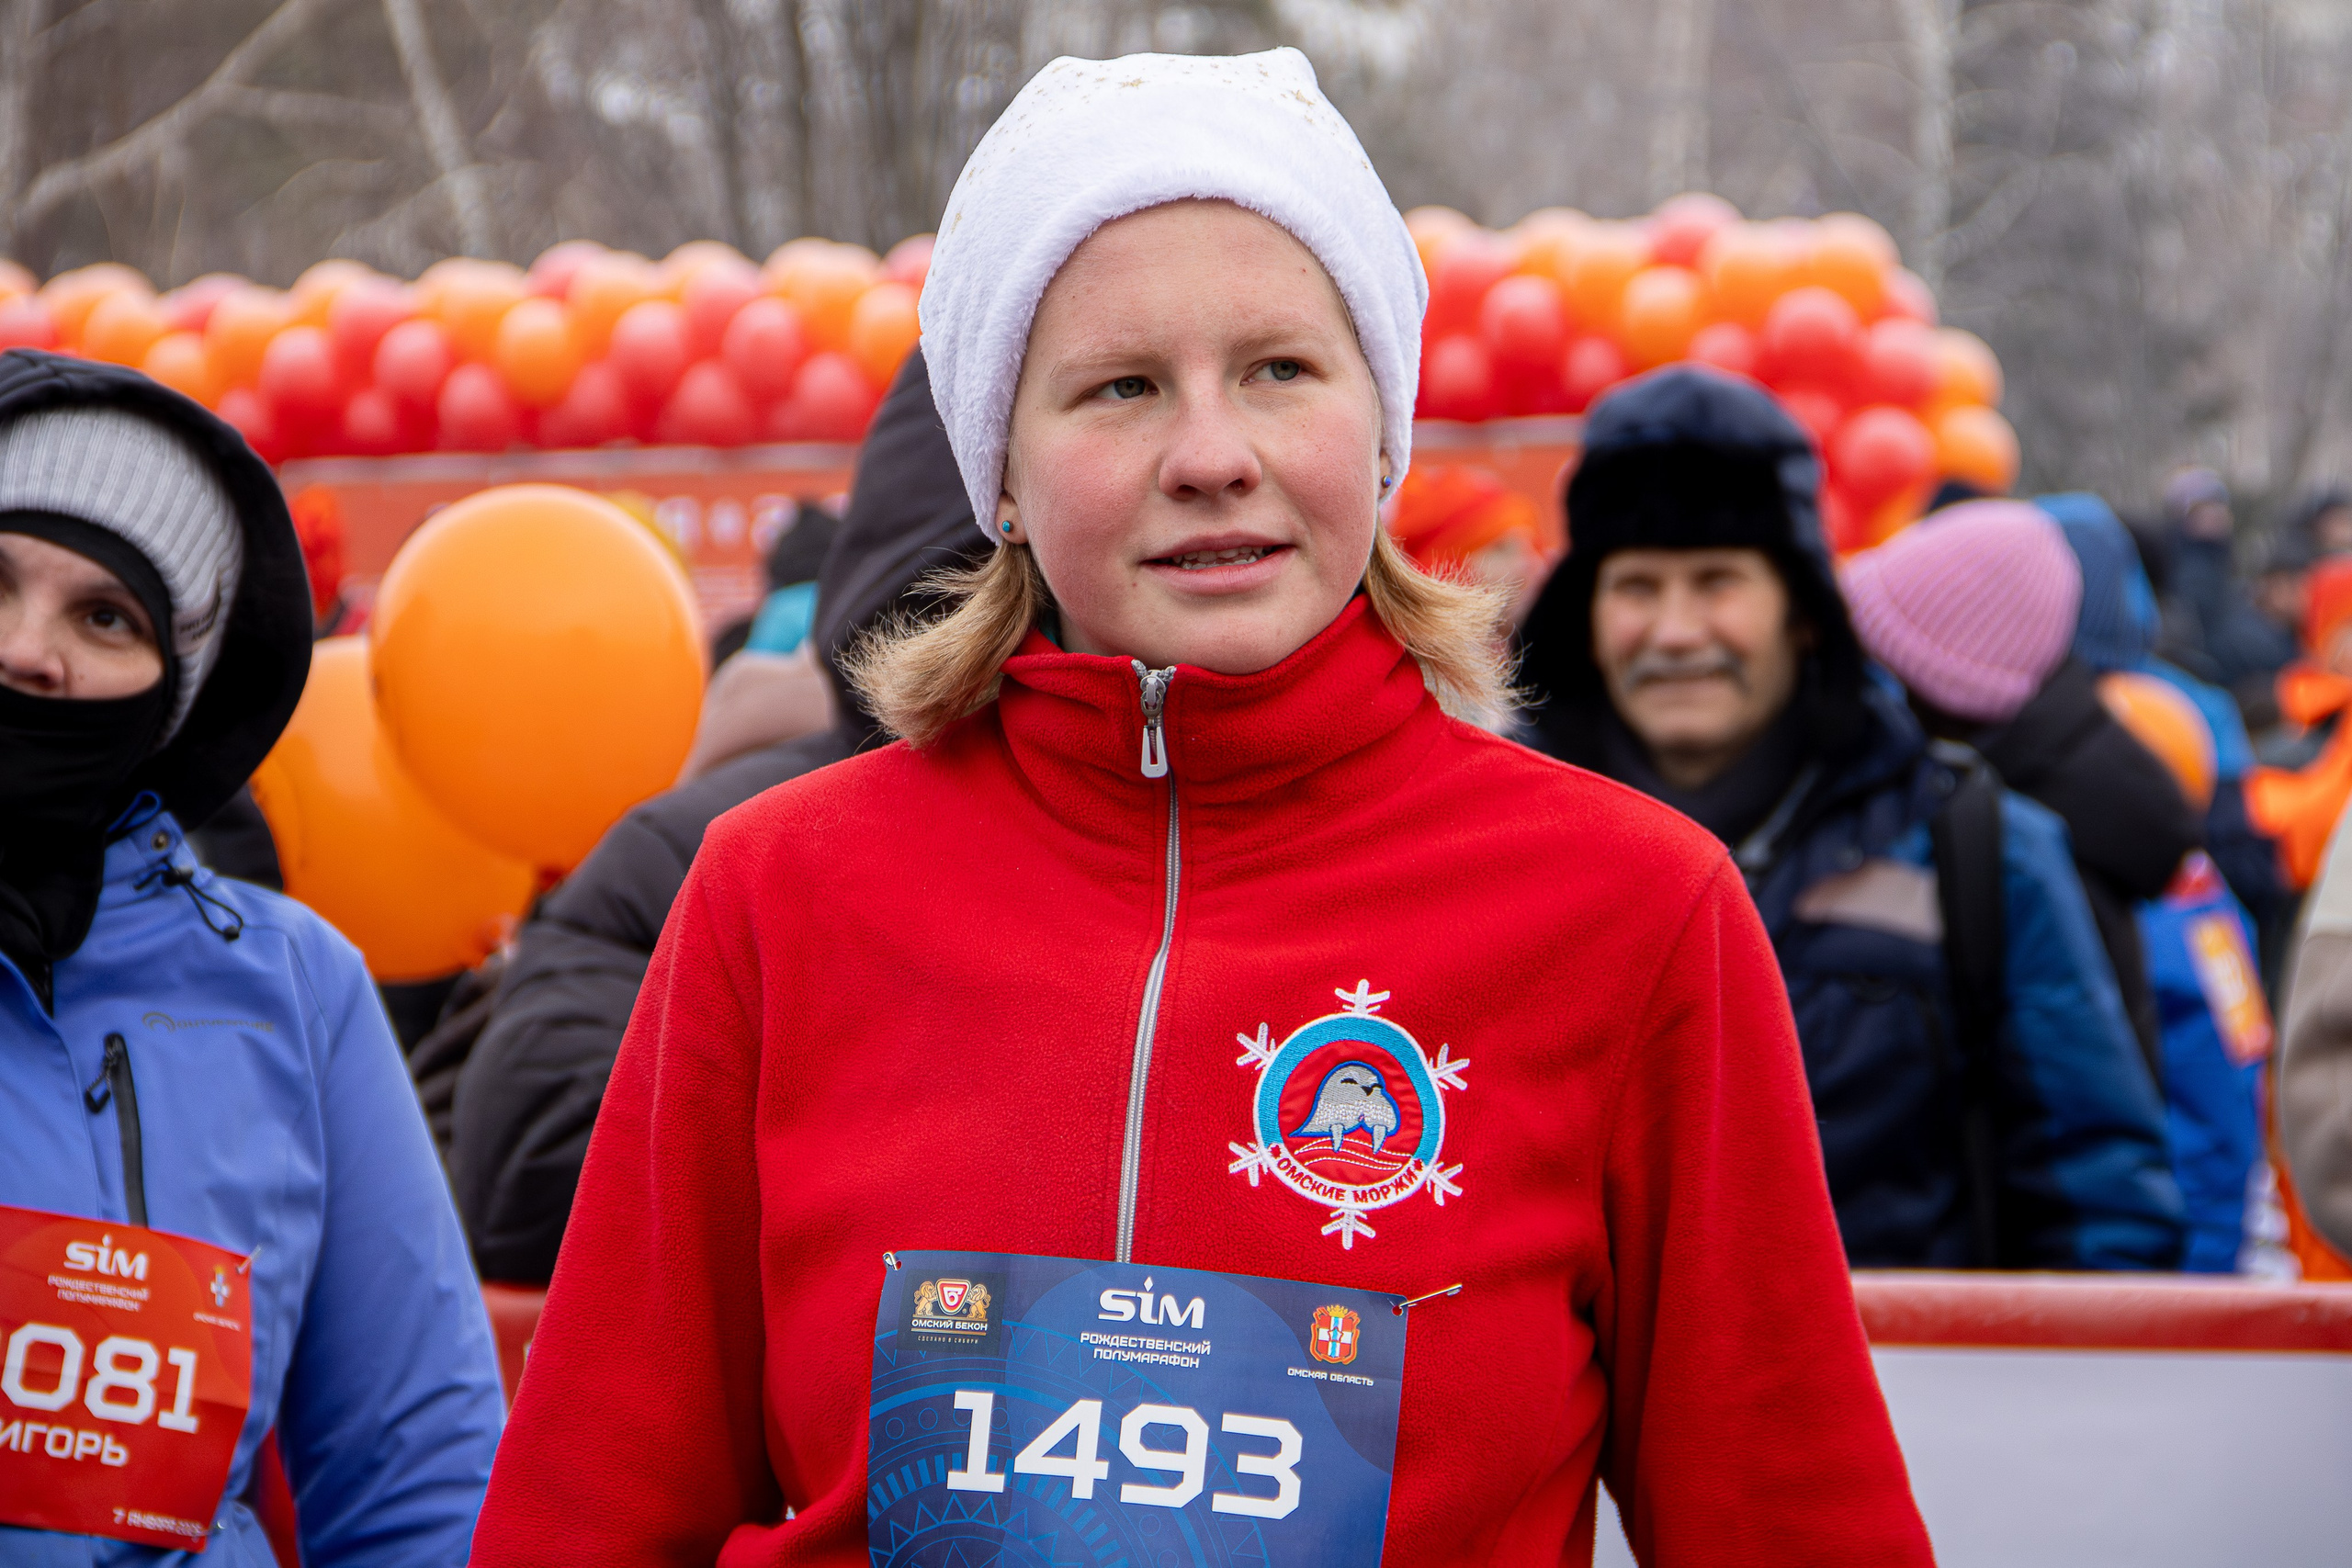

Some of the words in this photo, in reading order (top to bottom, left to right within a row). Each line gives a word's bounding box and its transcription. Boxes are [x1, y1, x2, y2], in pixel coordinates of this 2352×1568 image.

[1277, 1157, 1347, 1201] ОМСКИЕ
[1352, 1167, 1419, 1203] МОРЖИ
[911, 1318, 954, 1329] ОМСКИЙ
[955, 1321, 989, 1331] БЕКОН
[1080, 1332, 1212, 1356] РОЖДЕСТВЕНСКИЙ
[1093, 1348, 1200, 1369] ПОЛУМАРАФОН
[0, 1323, 199, 1434] 081
[1287, 1367, 1329, 1381] ОМСКАЯ
[1329, 1372, 1374, 1386] ОБЛАСТЬ
[946, 1389, 1304, 1521] 1493
